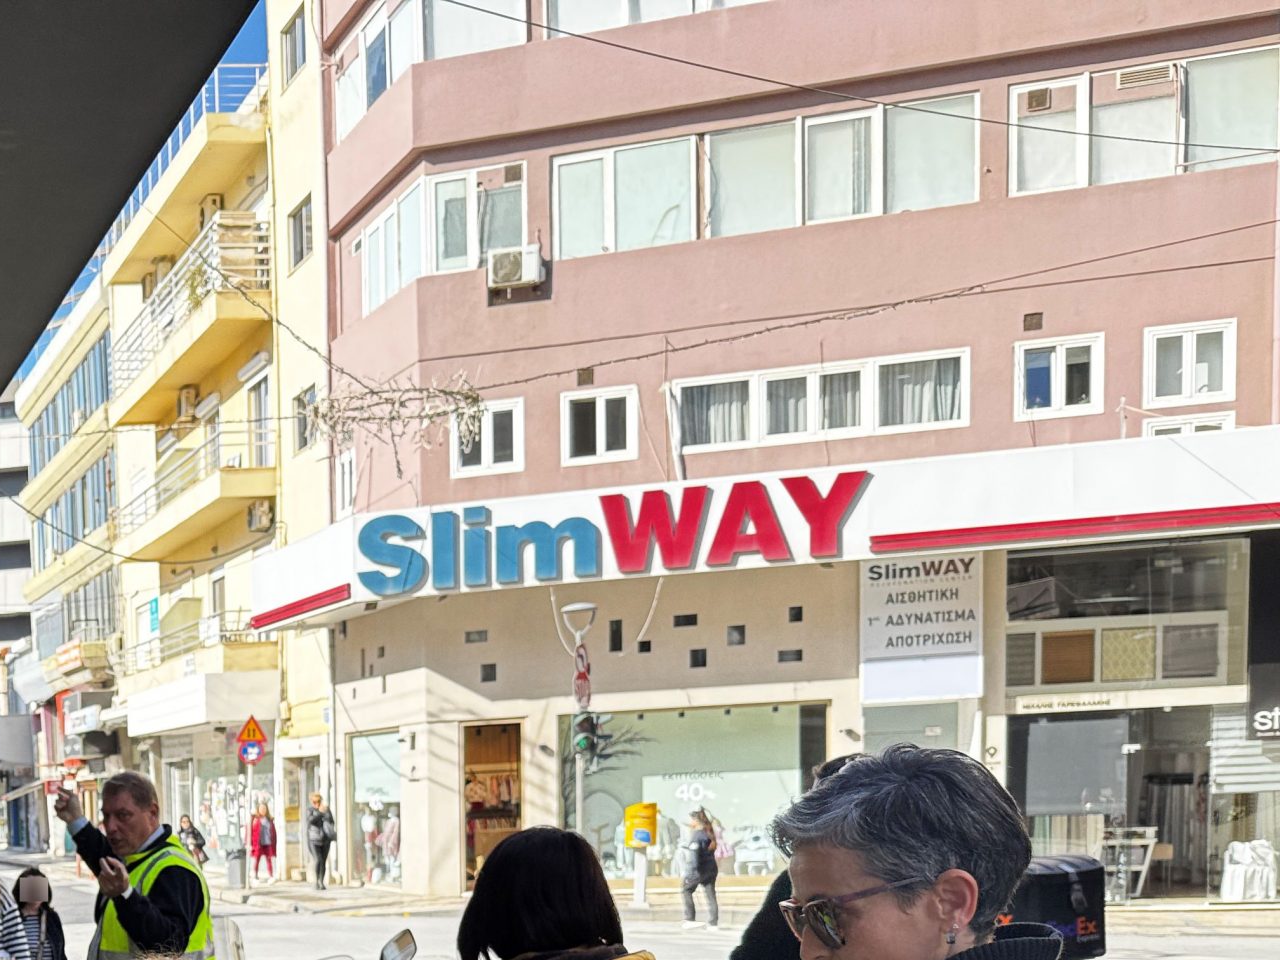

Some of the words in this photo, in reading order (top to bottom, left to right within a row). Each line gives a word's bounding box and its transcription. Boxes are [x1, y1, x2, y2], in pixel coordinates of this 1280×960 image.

[357, 470, 874, 598] SlimWAY
[868, 557, 975, 581] SlimWAY
[885, 588, 959, 605] ΑΙΣΘΗΤΙΚΗ
[885, 608, 976, 627] ΑΔΥΝΑΤΙΣΜΑ
[885, 630, 972, 648] ΑΠΟΤΡΙΧΩΣΗ
